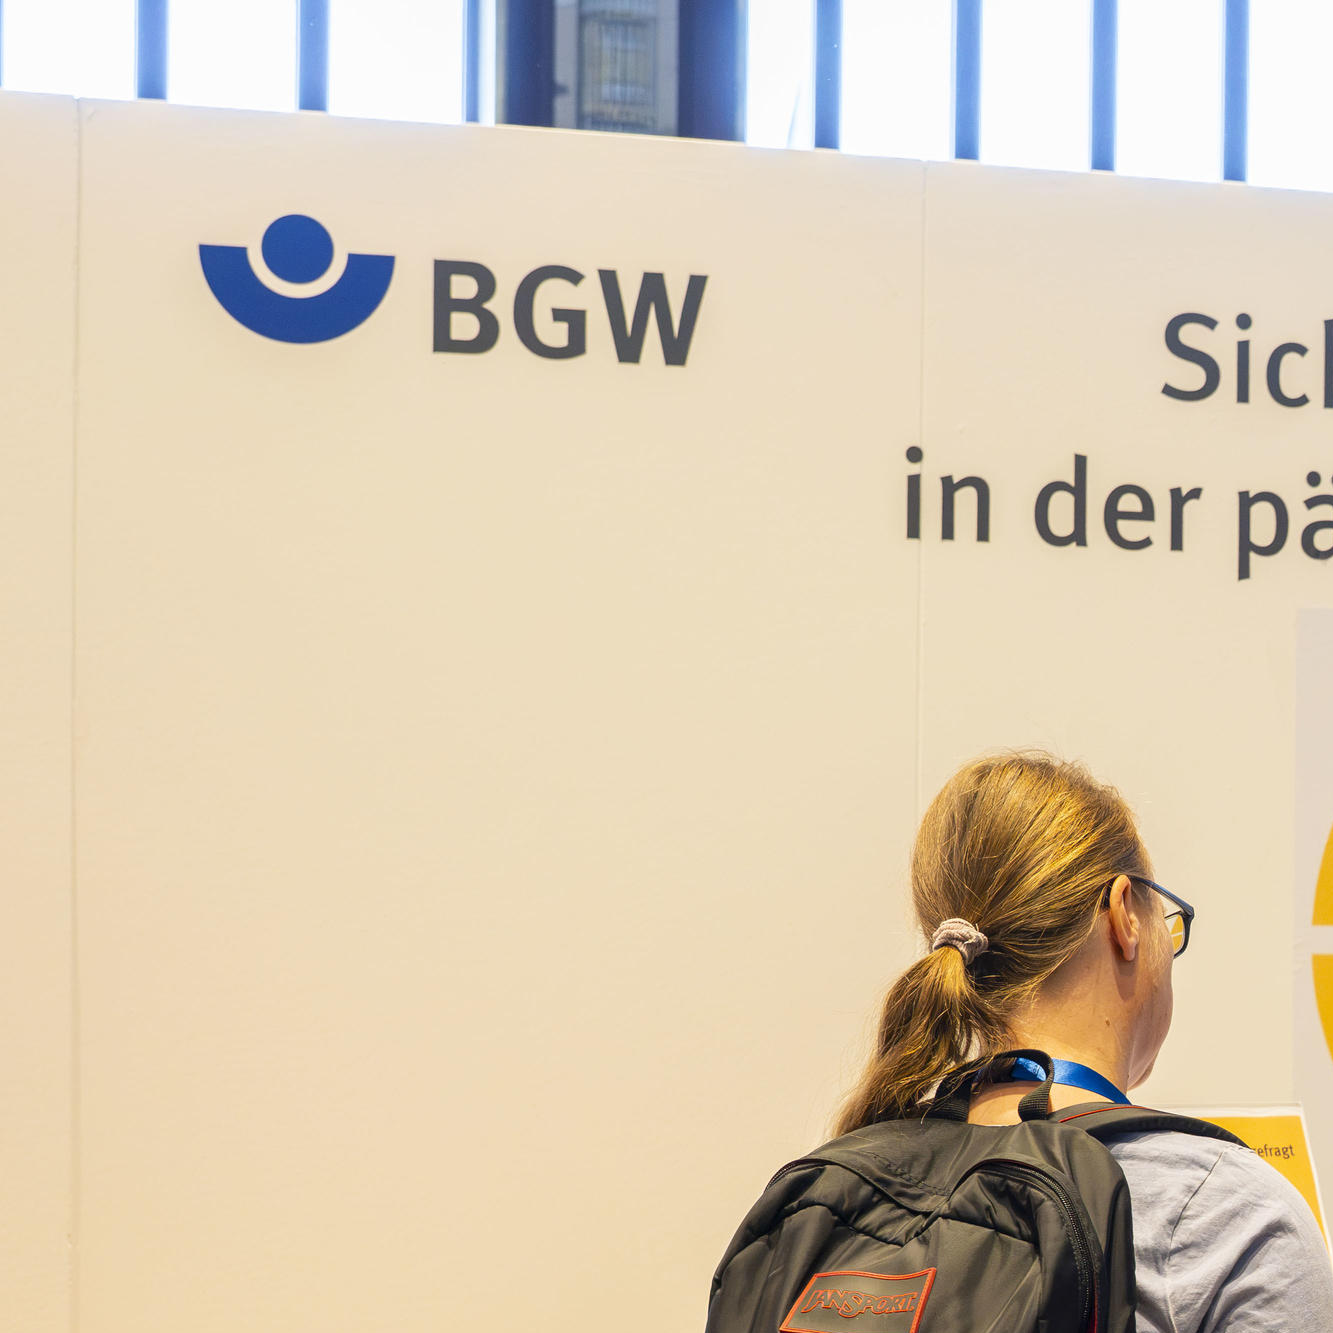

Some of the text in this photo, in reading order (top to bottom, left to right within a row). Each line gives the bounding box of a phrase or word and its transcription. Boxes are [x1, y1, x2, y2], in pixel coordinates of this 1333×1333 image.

[432, 258, 709, 368] BGW
[905, 445, 991, 543] in
[1033, 453, 1204, 552] der
[1251, 1143, 1296, 1159] efragt
